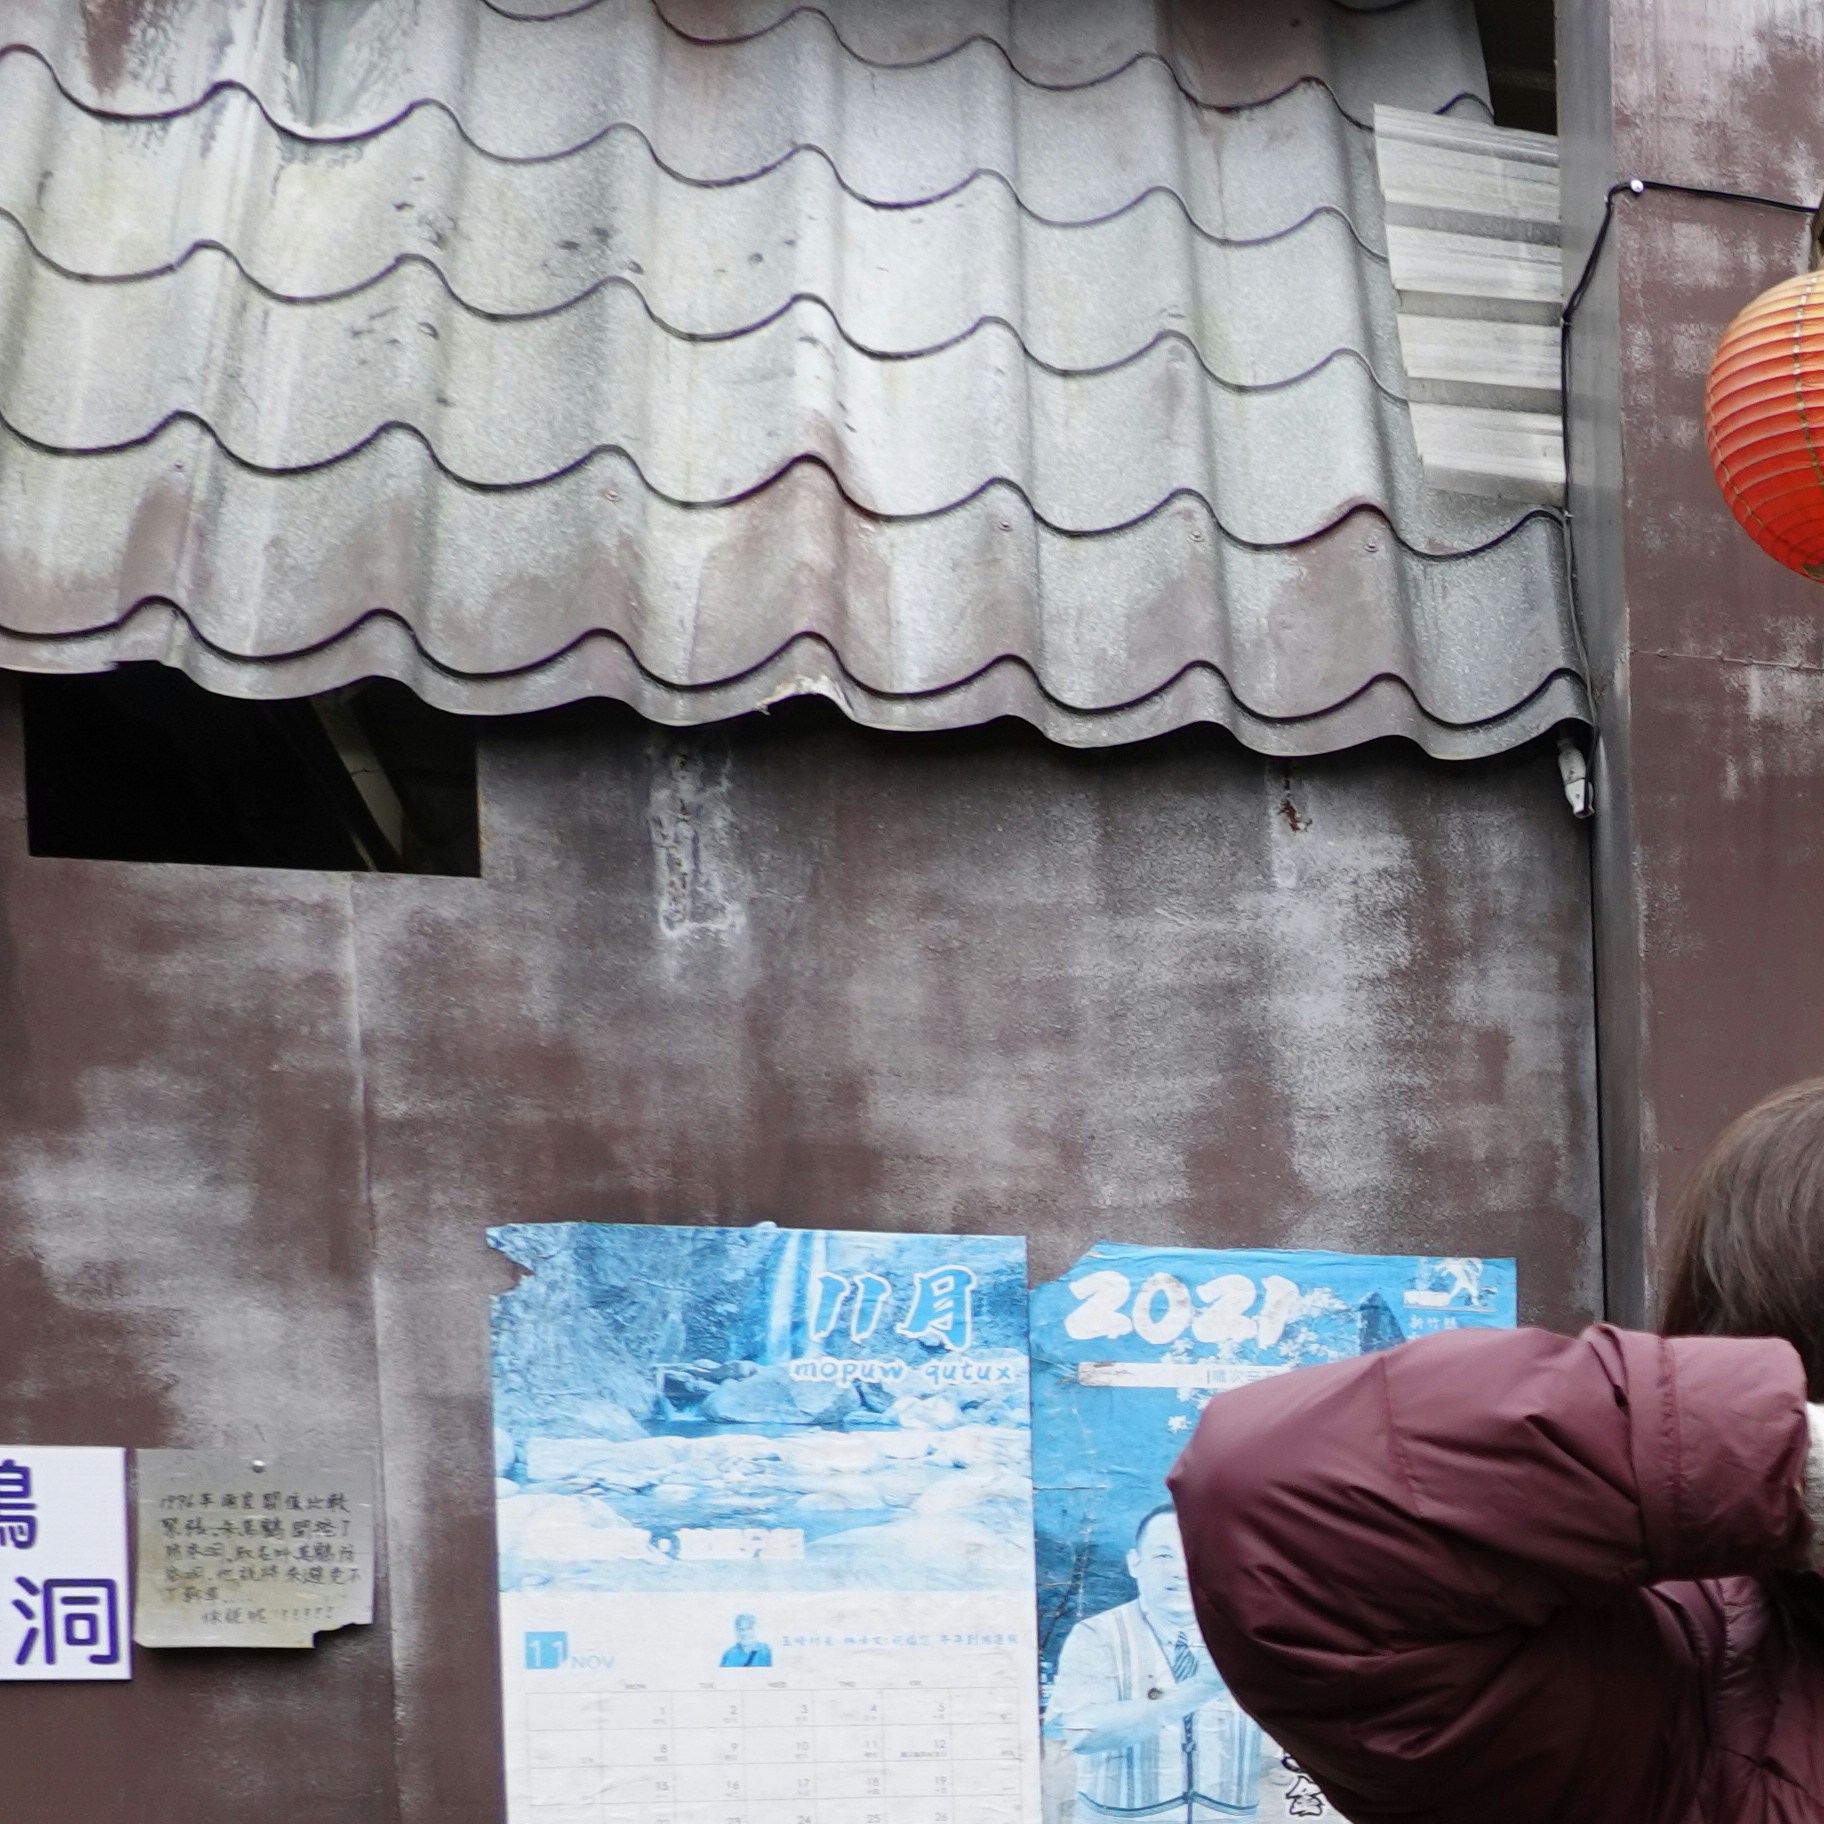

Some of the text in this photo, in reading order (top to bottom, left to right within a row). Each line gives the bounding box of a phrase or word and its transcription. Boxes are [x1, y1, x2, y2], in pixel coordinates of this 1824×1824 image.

[1064, 1270, 1301, 1350] 2021
[793, 1359, 1013, 1386] mopuw qutux
[11, 1575, 120, 1665] 洞
[571, 1655, 615, 1669] NOV
